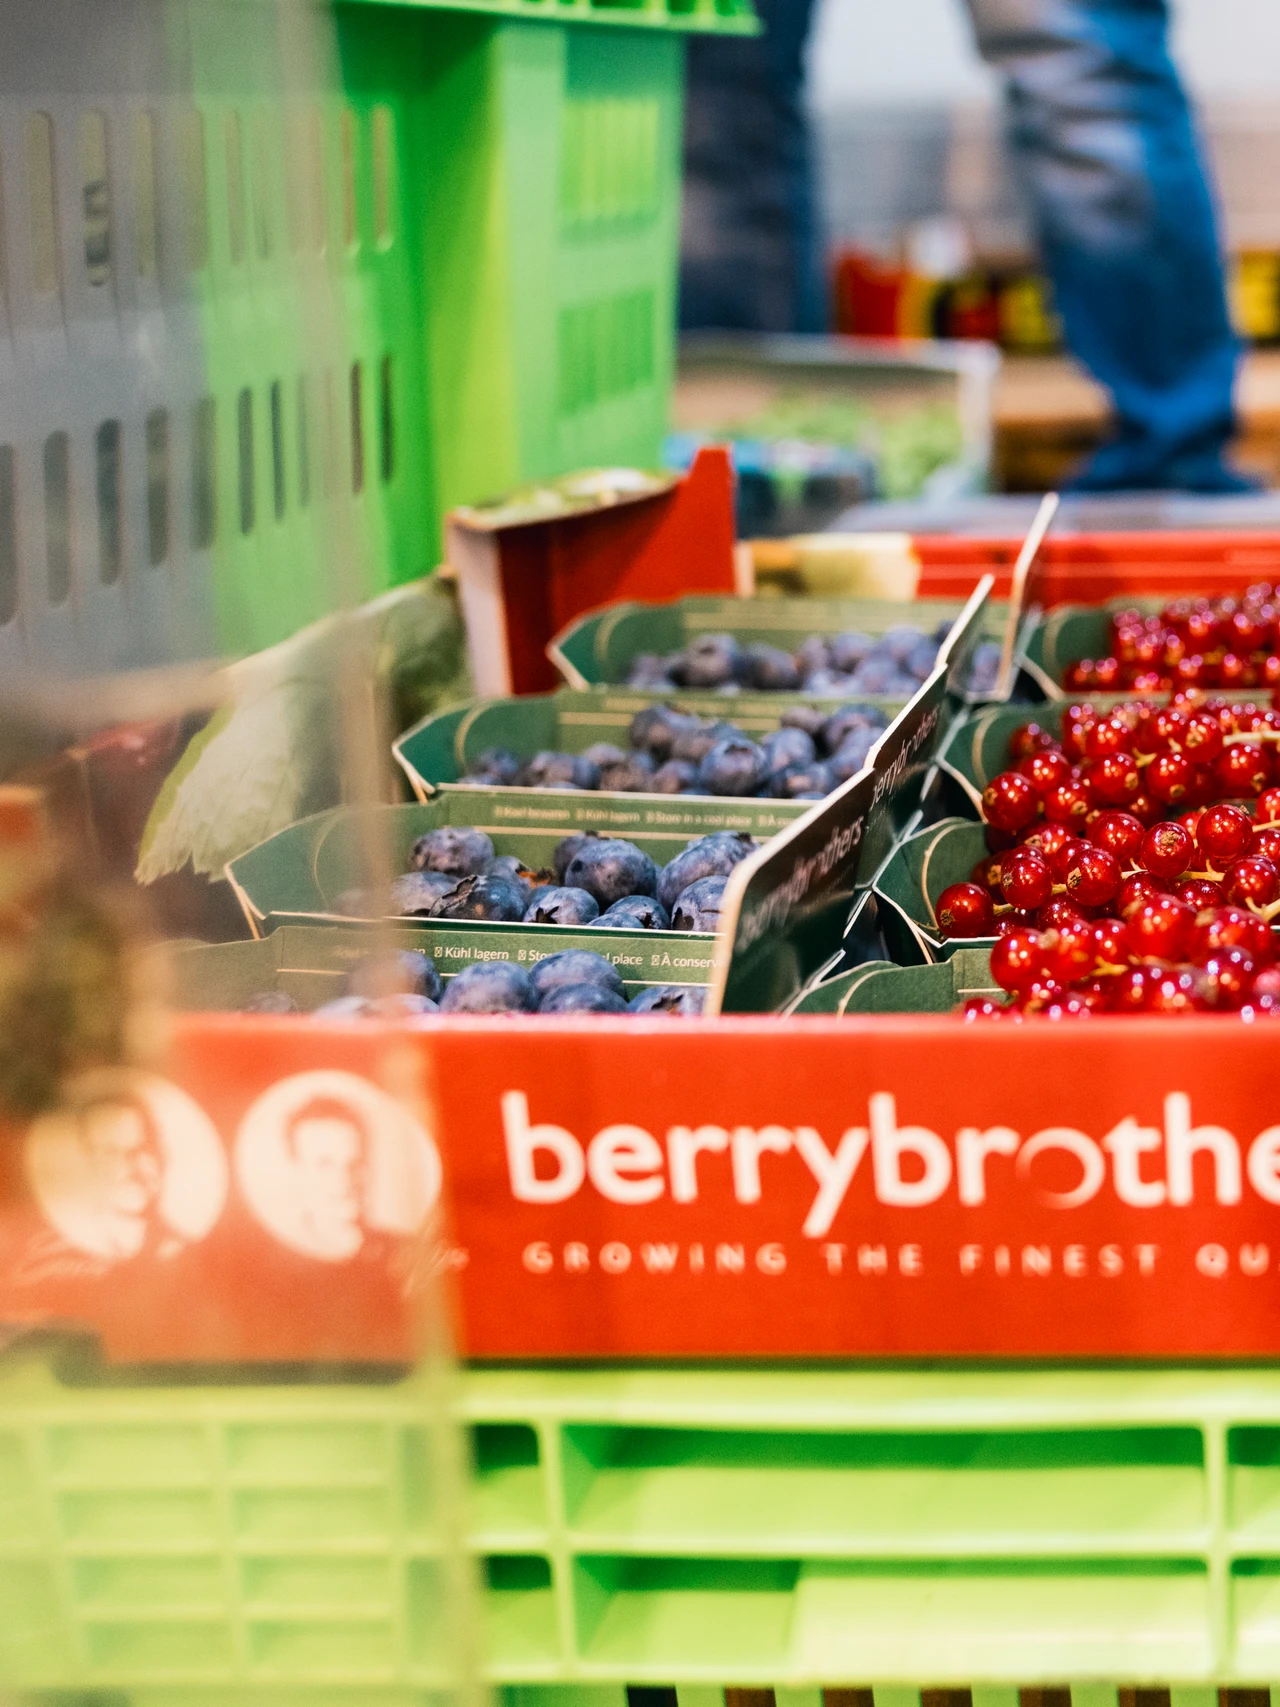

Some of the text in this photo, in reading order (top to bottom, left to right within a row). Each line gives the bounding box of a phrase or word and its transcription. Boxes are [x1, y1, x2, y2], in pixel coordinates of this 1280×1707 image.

[445, 947, 471, 959] Kühl
[474, 948, 509, 961] lagern
[528, 949, 552, 962] Sto
[612, 953, 643, 967] place
[661, 951, 671, 966] À
[672, 957, 722, 968] conserv
[522, 1241, 788, 1275] GROWING
[819, 1242, 925, 1276] THE
[958, 1242, 1160, 1278] FINEST
